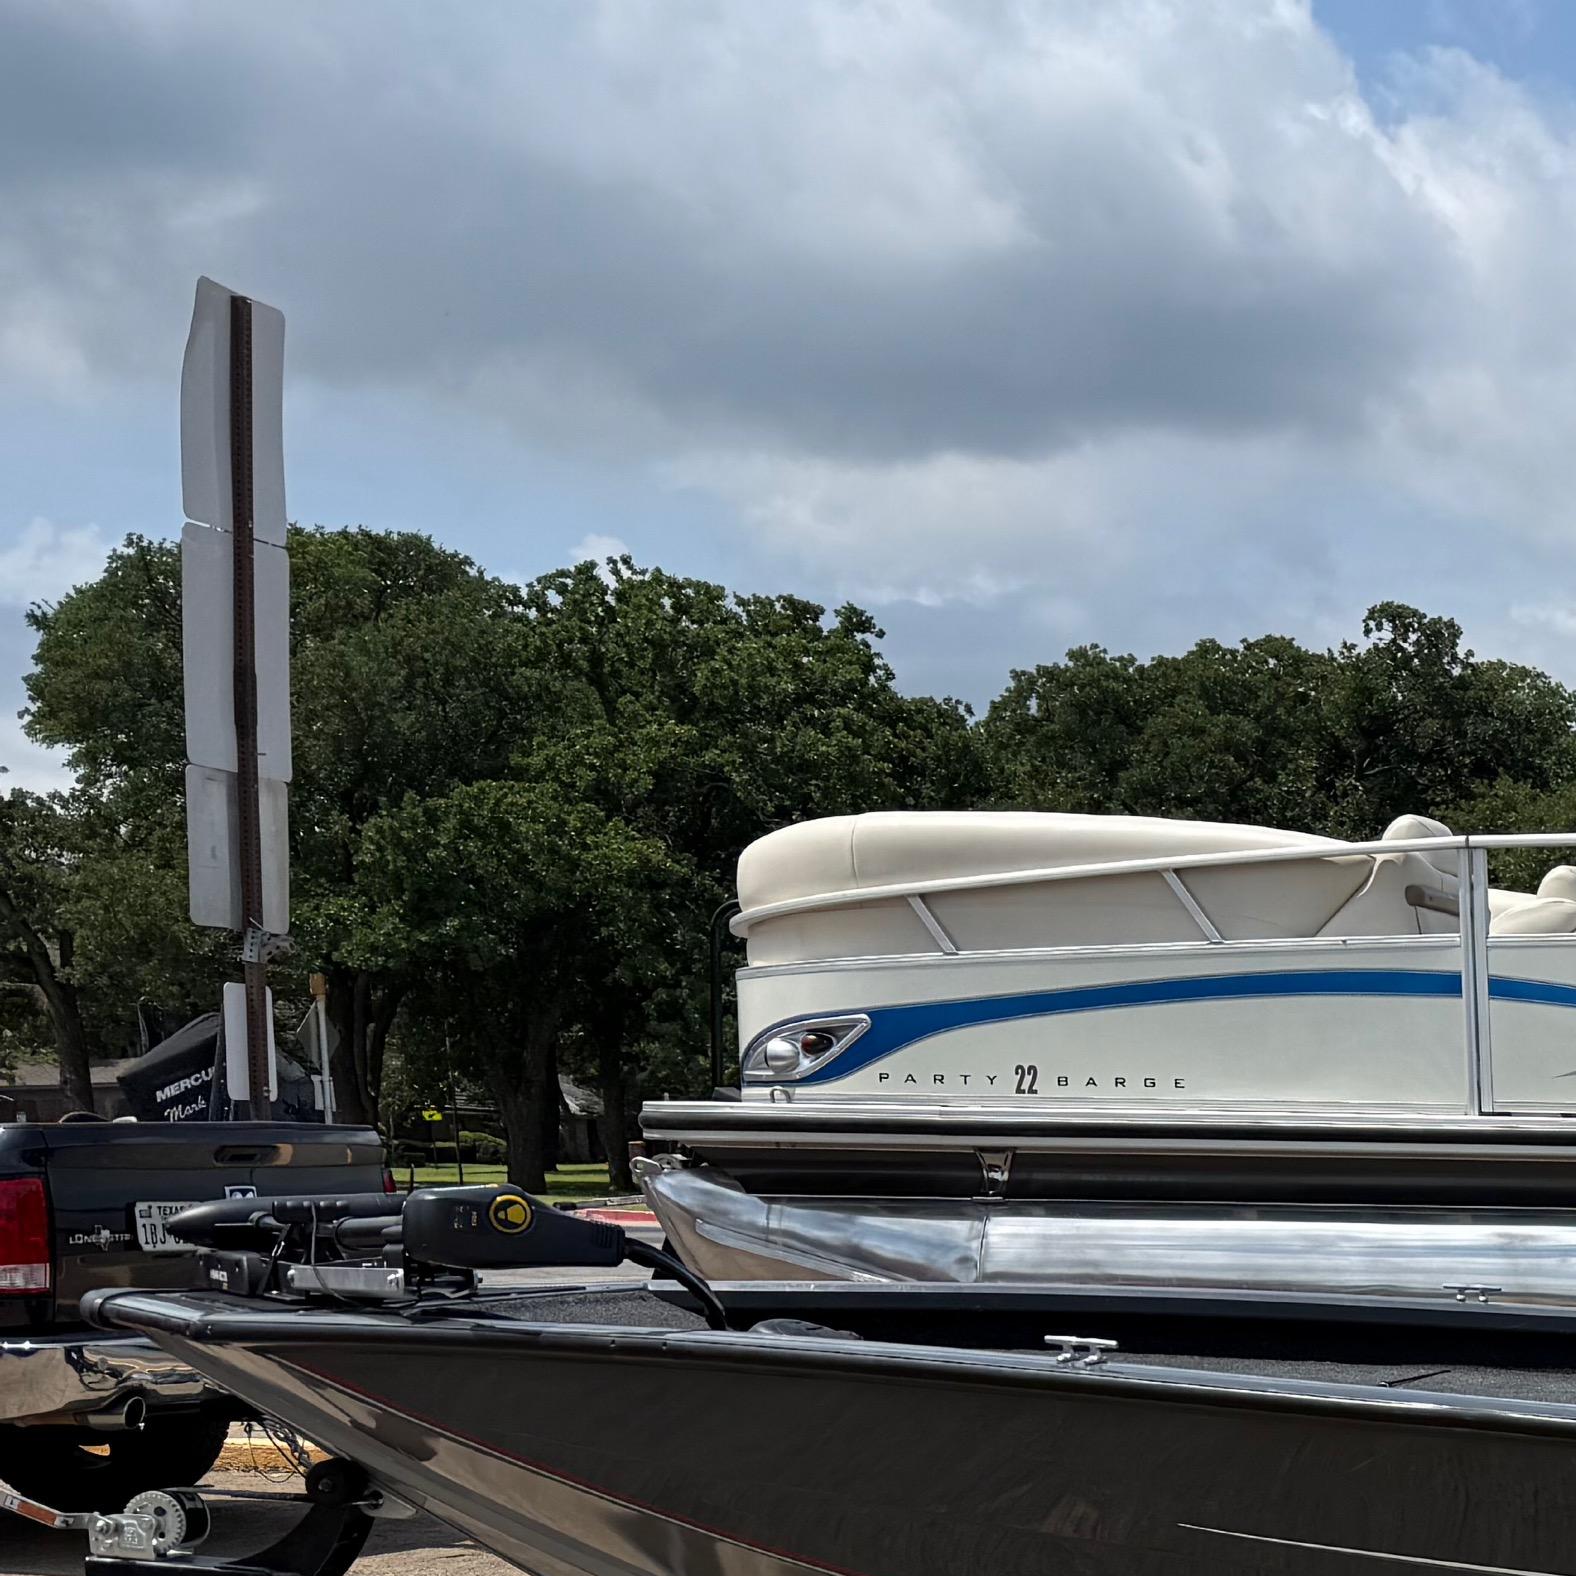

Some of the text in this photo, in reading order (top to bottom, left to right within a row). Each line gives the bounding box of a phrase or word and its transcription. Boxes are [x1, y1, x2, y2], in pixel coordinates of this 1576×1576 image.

[156, 1066, 216, 1103] MERCU
[878, 1064, 1186, 1095] PARTY 22 BARGE
[164, 1096, 206, 1123] Mark
